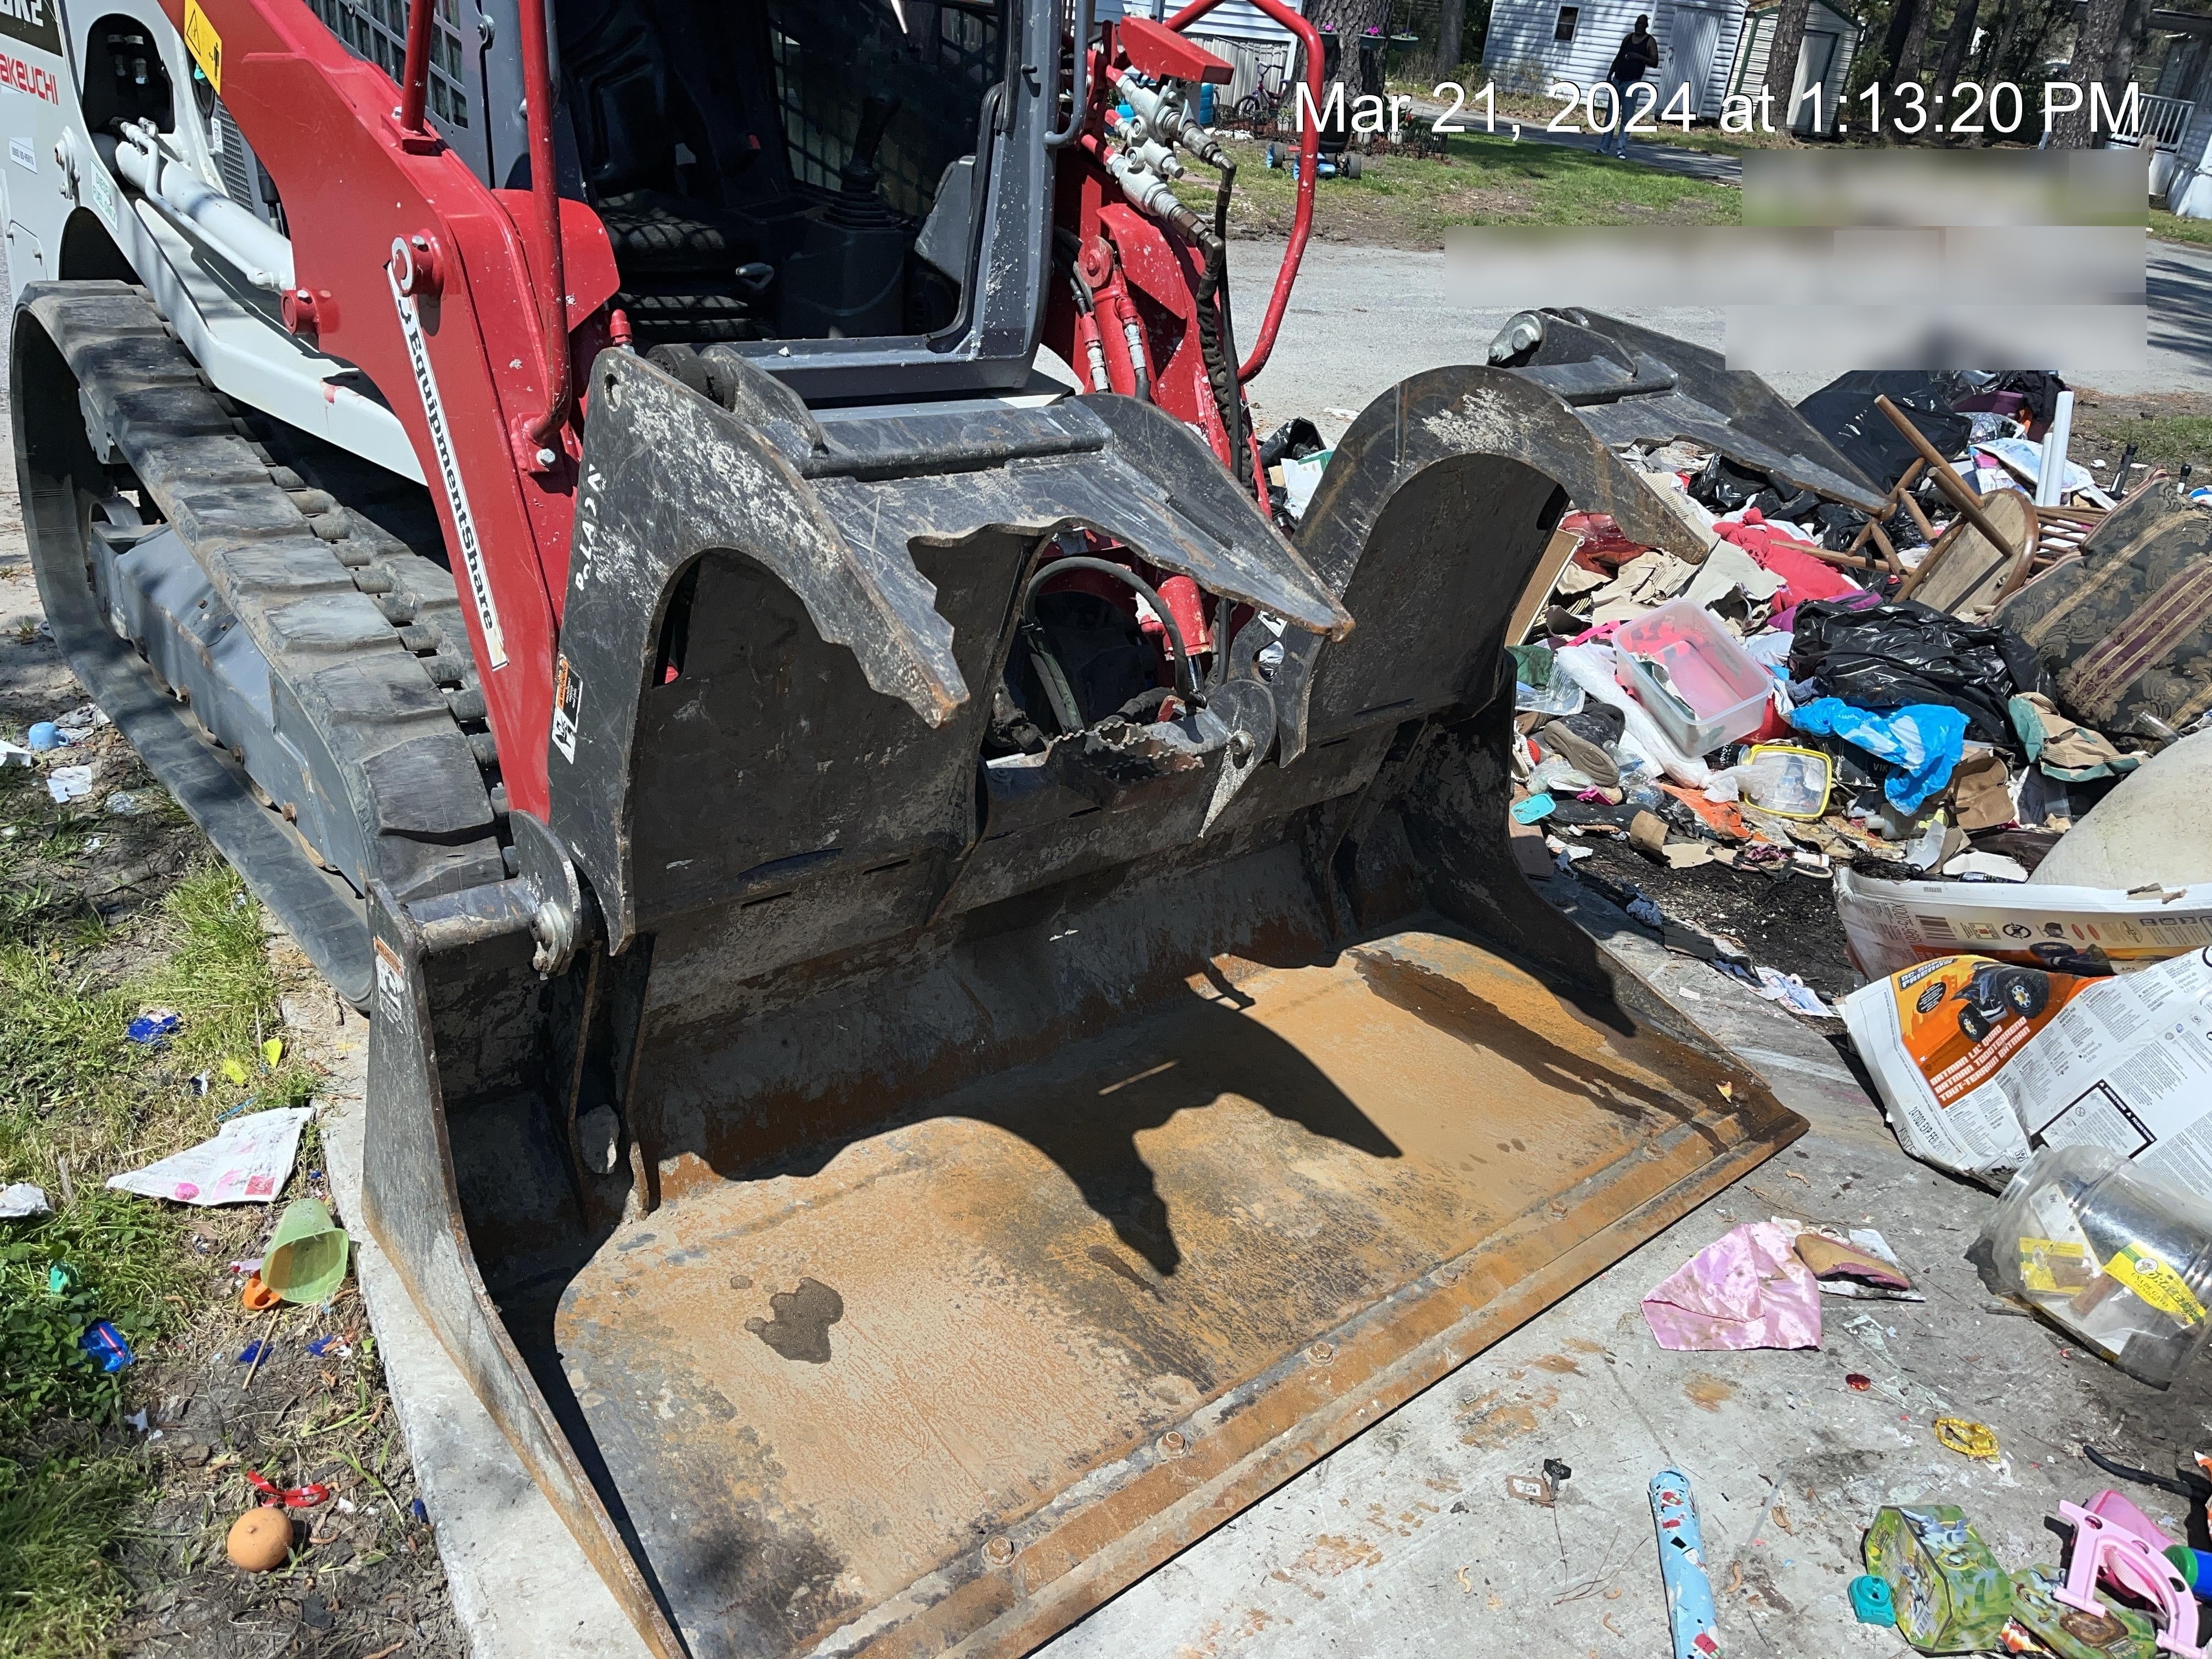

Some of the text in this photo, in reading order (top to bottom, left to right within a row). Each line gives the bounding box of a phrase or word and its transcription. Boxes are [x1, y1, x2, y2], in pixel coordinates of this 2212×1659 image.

[409, 329, 493, 630] EquipmentShare
[1929, 1056, 1970, 1086] BATMAN
[1934, 1064, 1975, 1094] BATMAN
